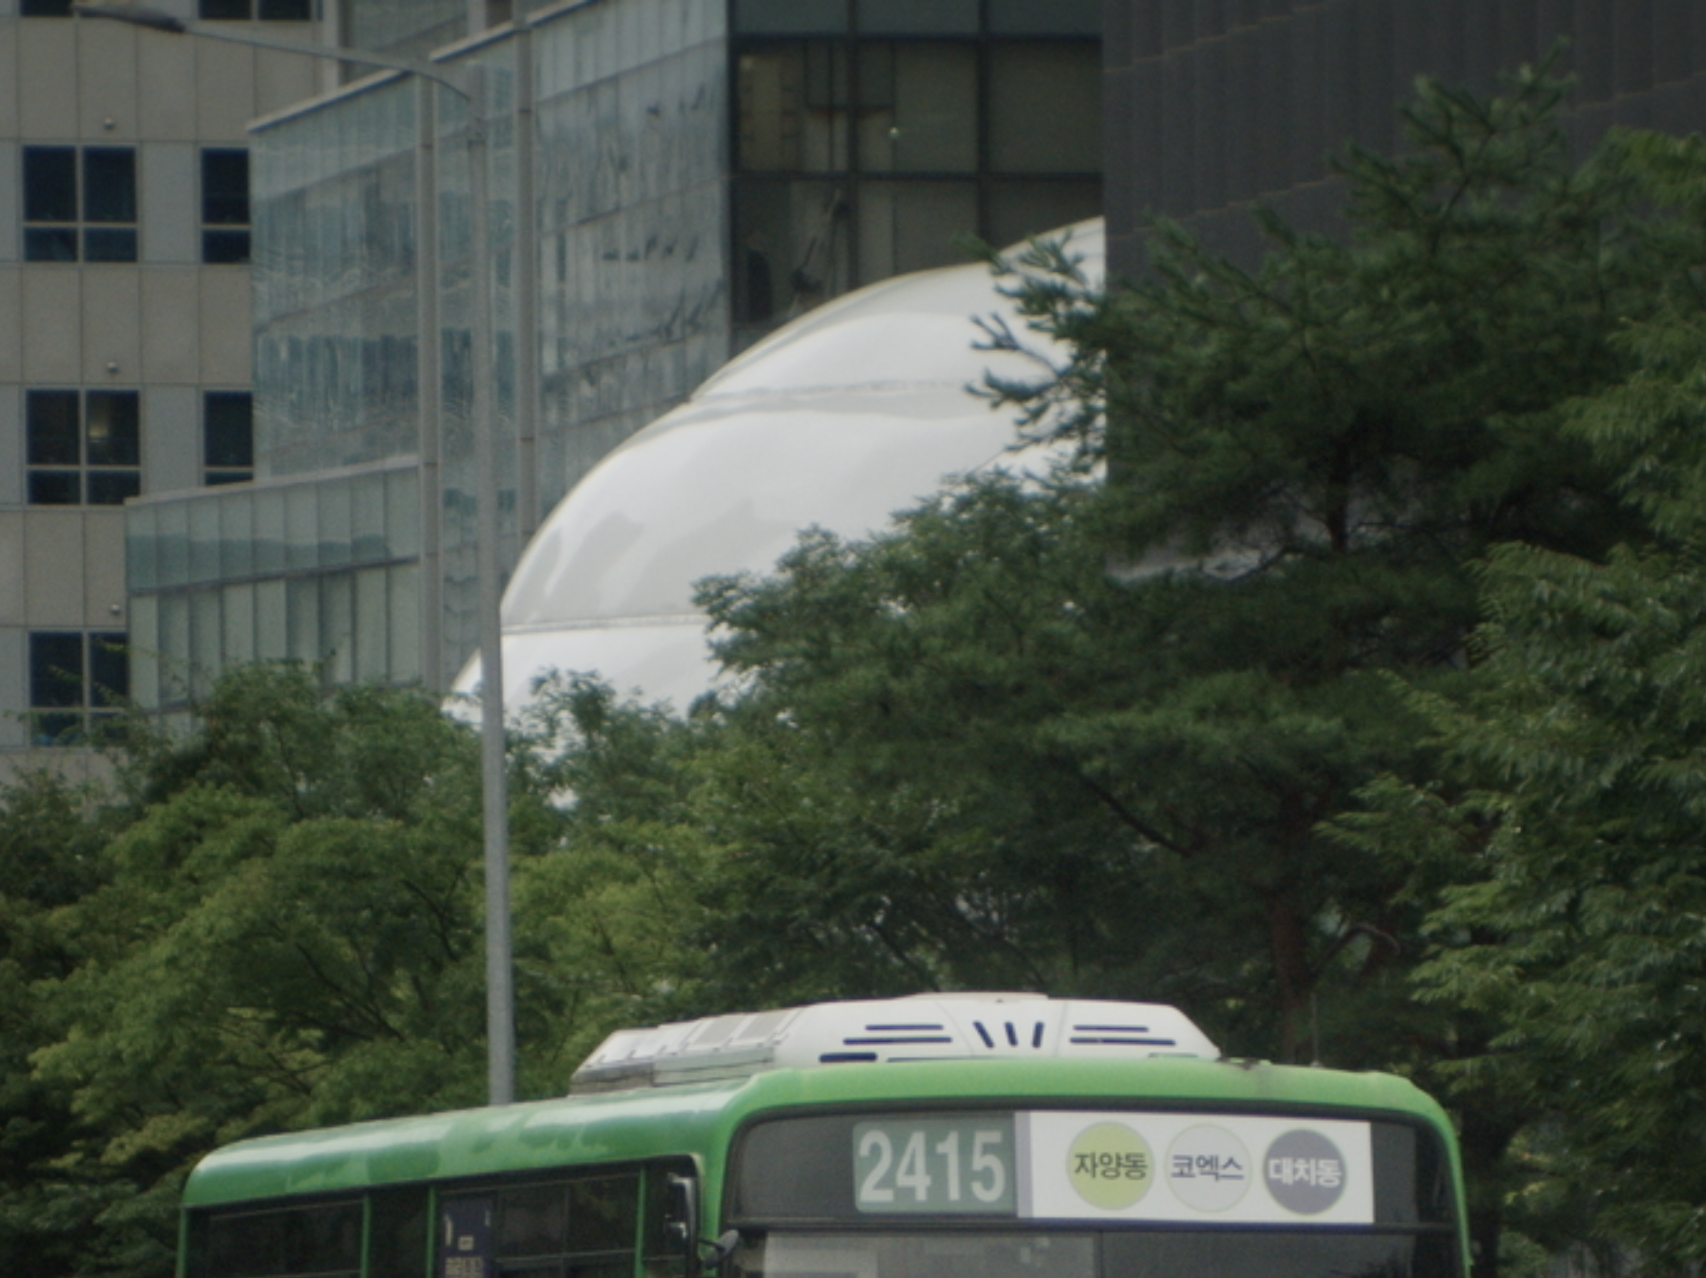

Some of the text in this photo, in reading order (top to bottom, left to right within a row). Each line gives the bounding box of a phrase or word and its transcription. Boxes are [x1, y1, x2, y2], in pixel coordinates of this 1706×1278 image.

[859, 1129, 1005, 1202] 2415
[1073, 1151, 1148, 1181] 자양동
[1170, 1153, 1245, 1182] 코엑스
[1267, 1154, 1343, 1185] 대치동
